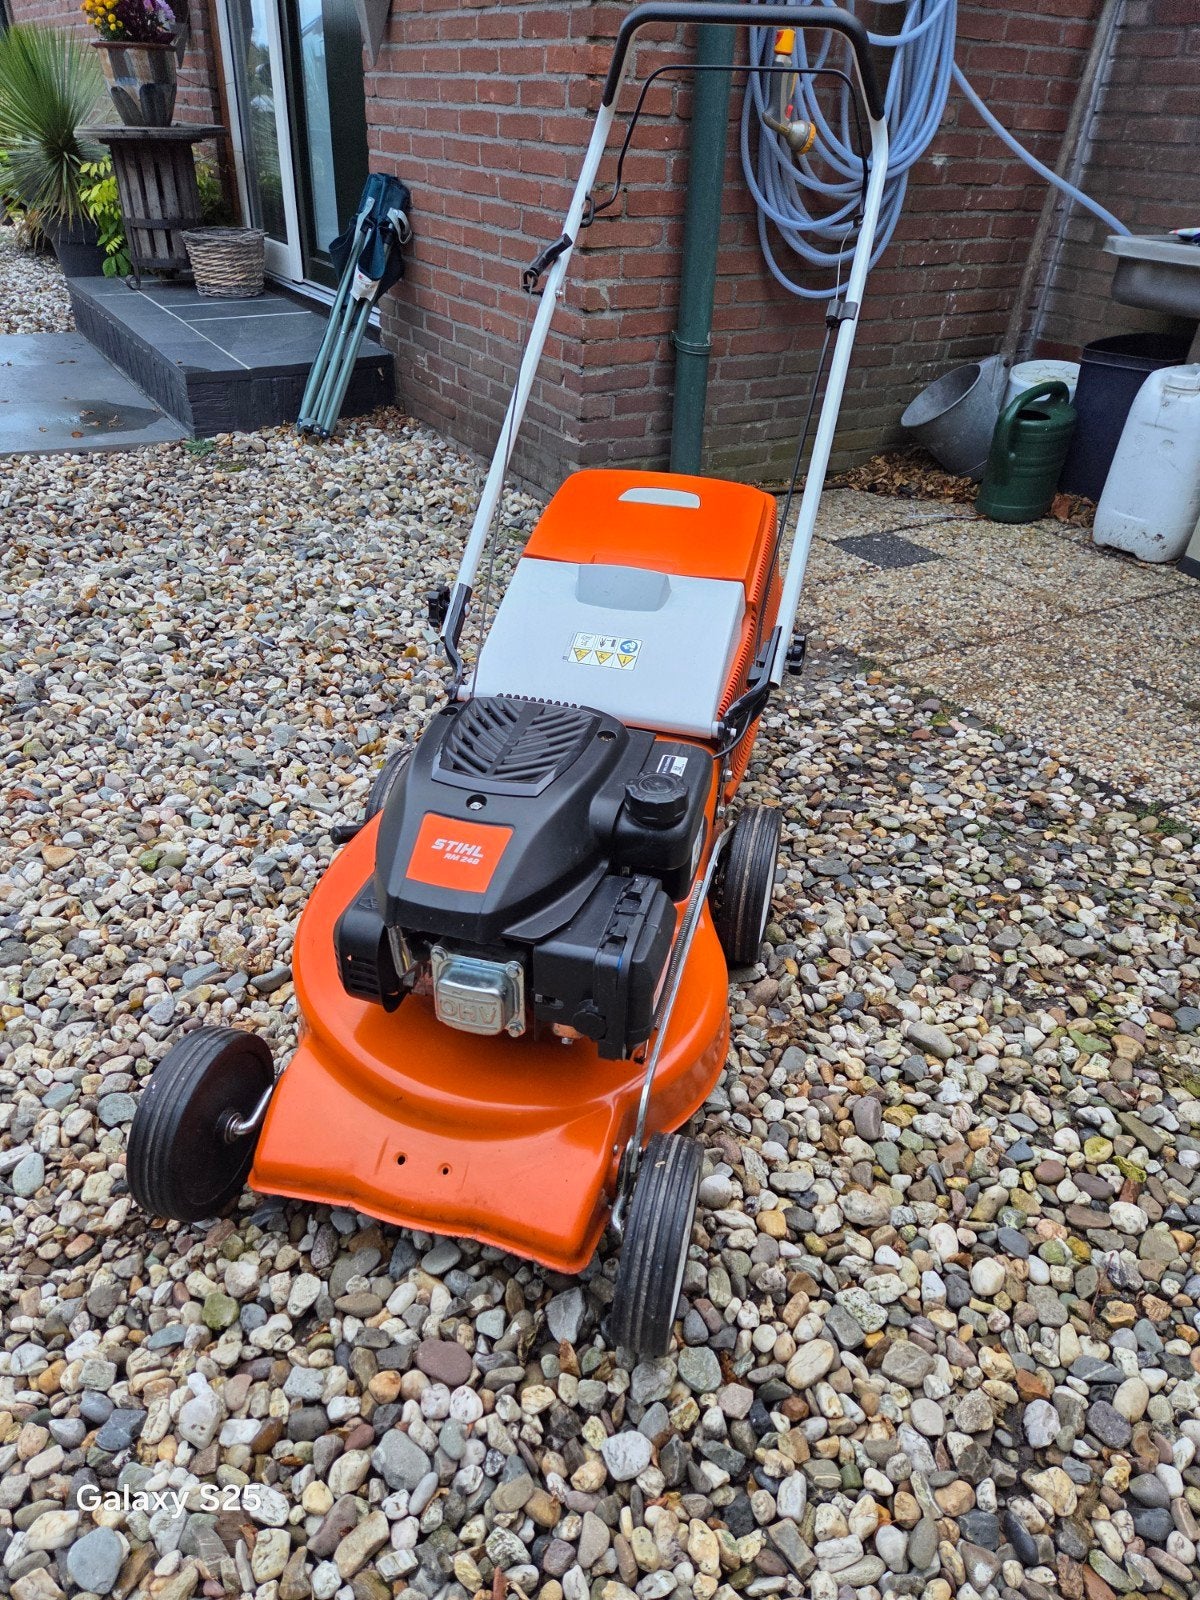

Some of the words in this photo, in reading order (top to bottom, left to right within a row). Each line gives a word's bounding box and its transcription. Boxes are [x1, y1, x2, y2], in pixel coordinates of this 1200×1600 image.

[431, 838, 484, 858] STIHL
[444, 852, 460, 861] RM
[441, 999, 498, 1025] OHV
